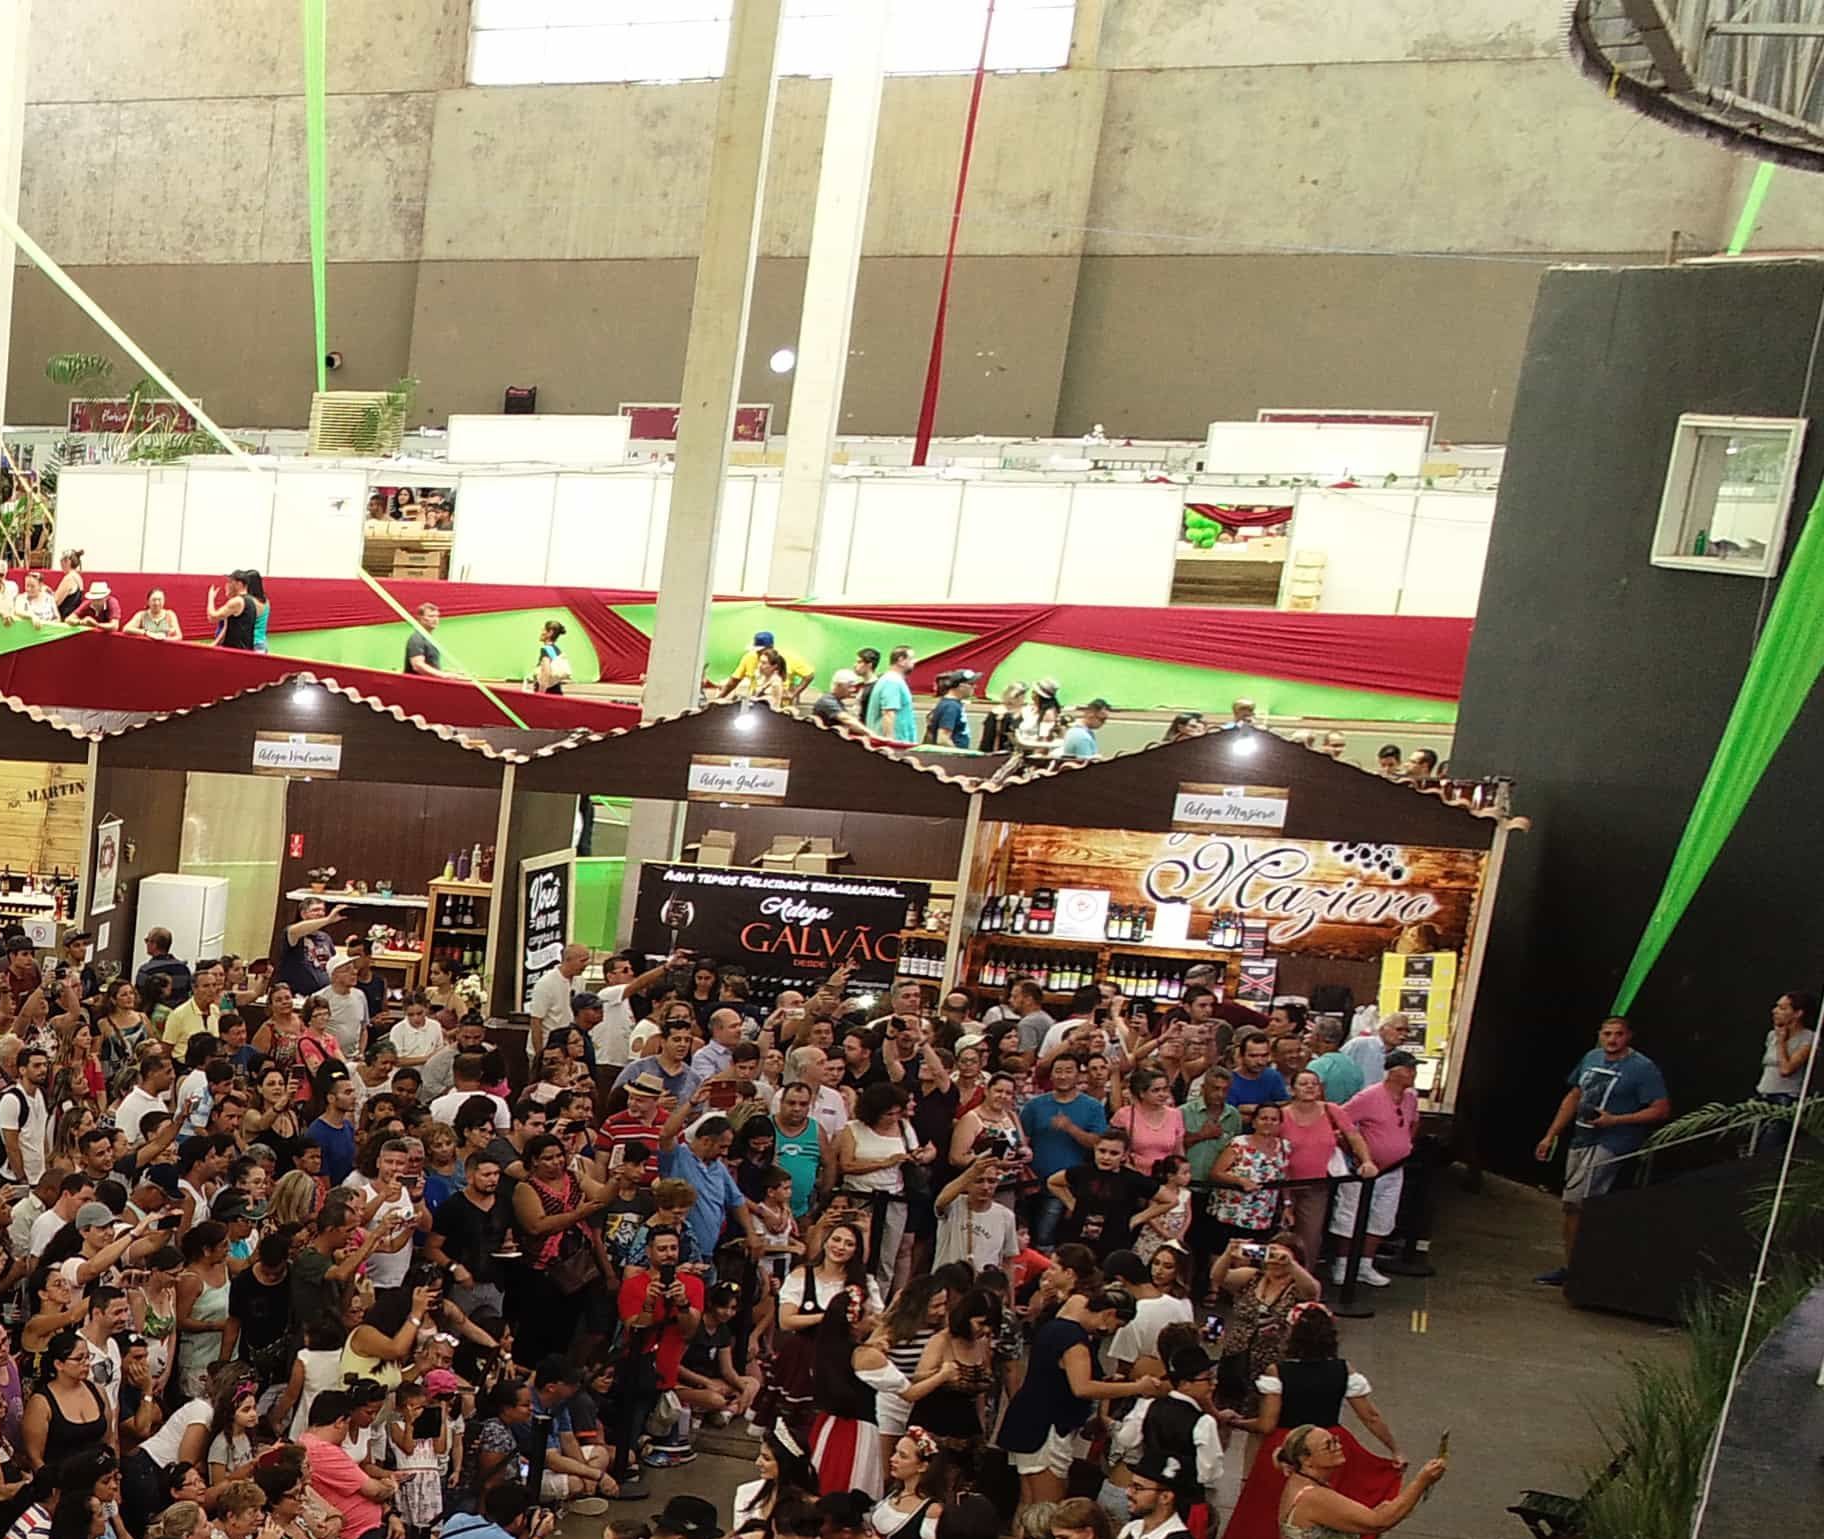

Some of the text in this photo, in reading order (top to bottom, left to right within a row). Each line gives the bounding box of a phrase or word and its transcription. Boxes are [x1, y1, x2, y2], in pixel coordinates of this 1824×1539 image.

[700, 773, 732, 788] Adega
[26, 780, 88, 803] MARTIN
[1184, 801, 1221, 820] Adega
[1145, 842, 1437, 943] Maziero
[759, 897, 833, 925] Adega
[792, 958, 827, 969] DESDE
